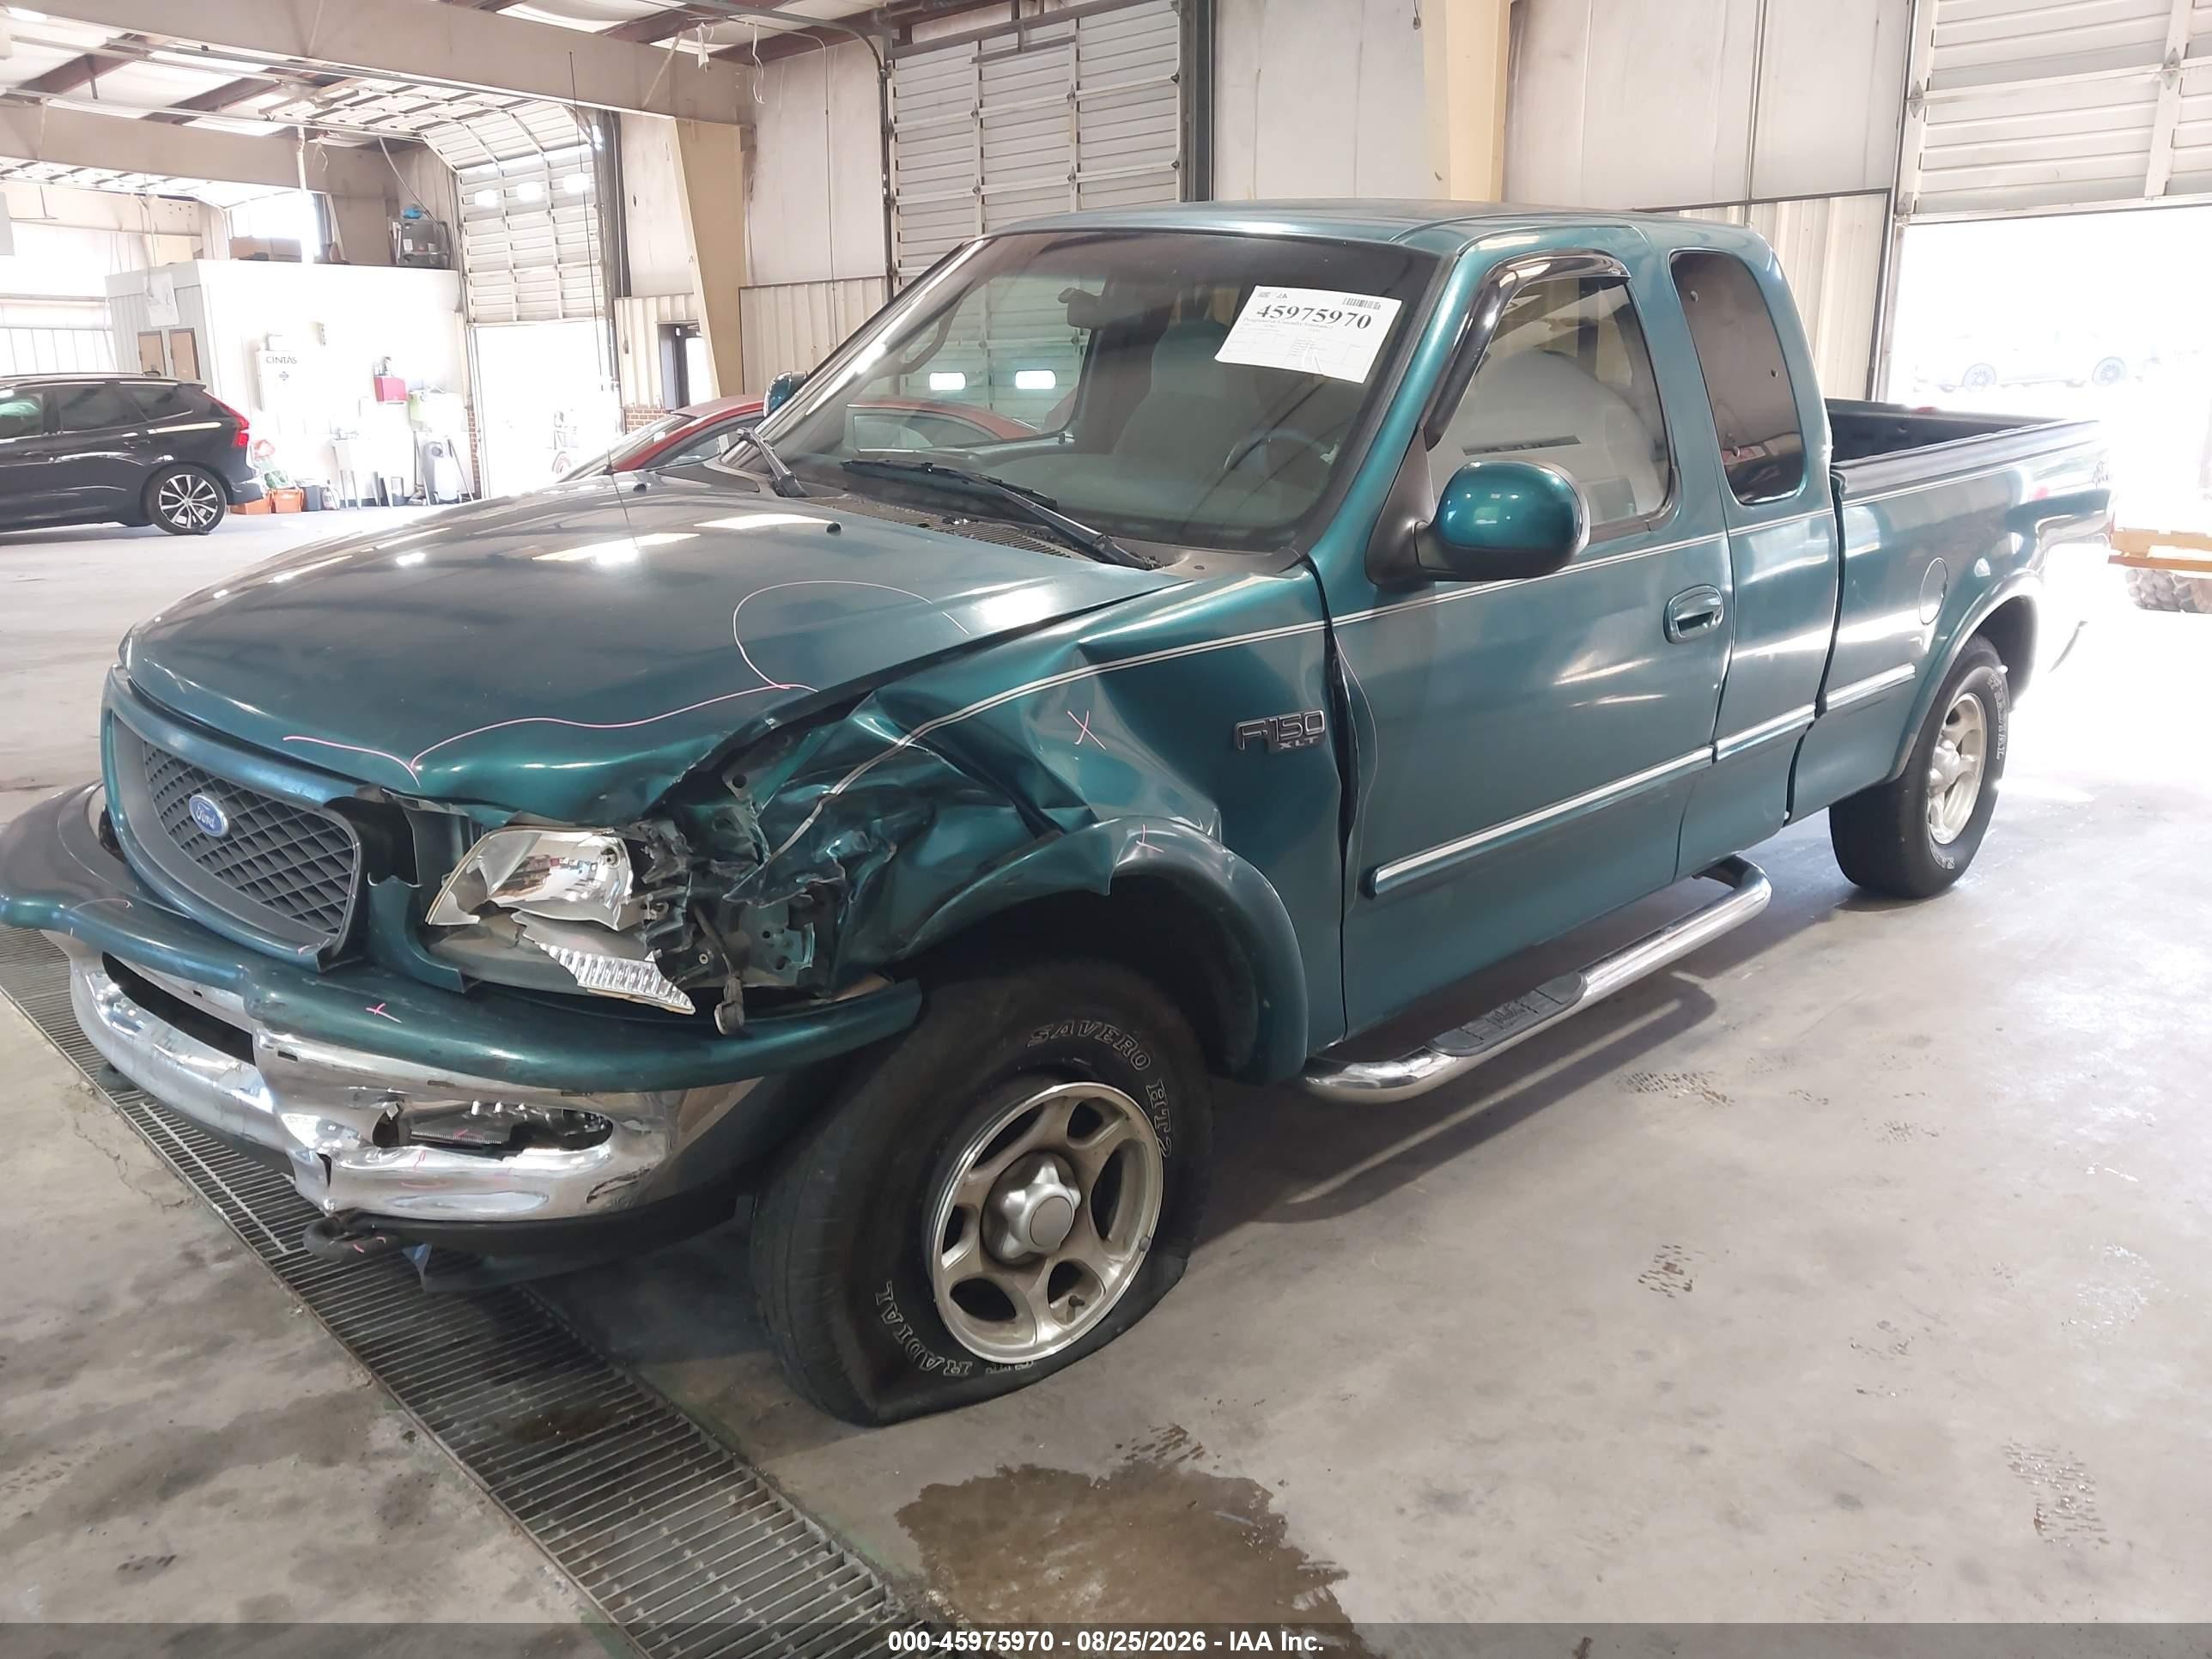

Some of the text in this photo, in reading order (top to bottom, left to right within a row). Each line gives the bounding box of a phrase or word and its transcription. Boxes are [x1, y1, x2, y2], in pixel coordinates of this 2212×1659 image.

[1256, 304, 1372, 330] 45975970
[265, 356, 298, 365] CINTAS
[1279, 736, 1319, 750] XLT
[195, 802, 216, 830] Ford
[1027, 1019, 1152, 1072] SAVERO
[874, 1279, 974, 1377] RADIAL
